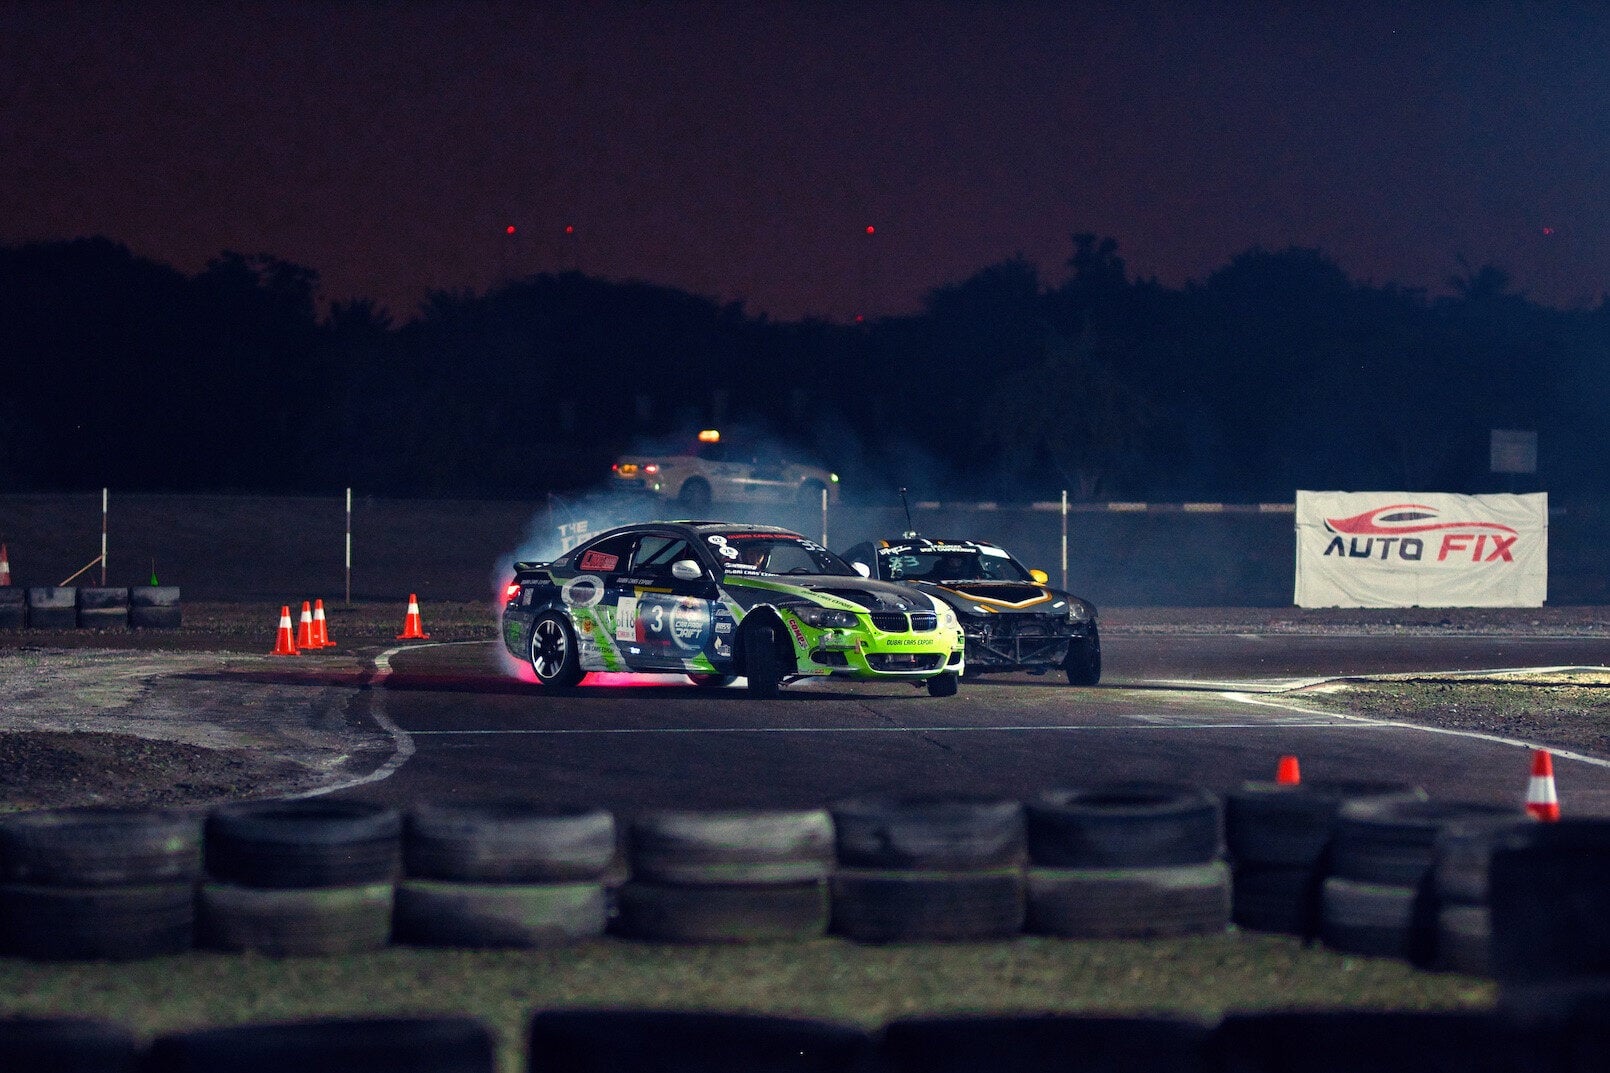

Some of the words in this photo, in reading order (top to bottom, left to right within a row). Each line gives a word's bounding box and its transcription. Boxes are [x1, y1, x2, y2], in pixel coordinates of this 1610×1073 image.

[1323, 536, 1425, 562] AUTO
[1436, 534, 1519, 563] FIX
[650, 605, 663, 633] 3
[675, 628, 704, 639] DRIFT
